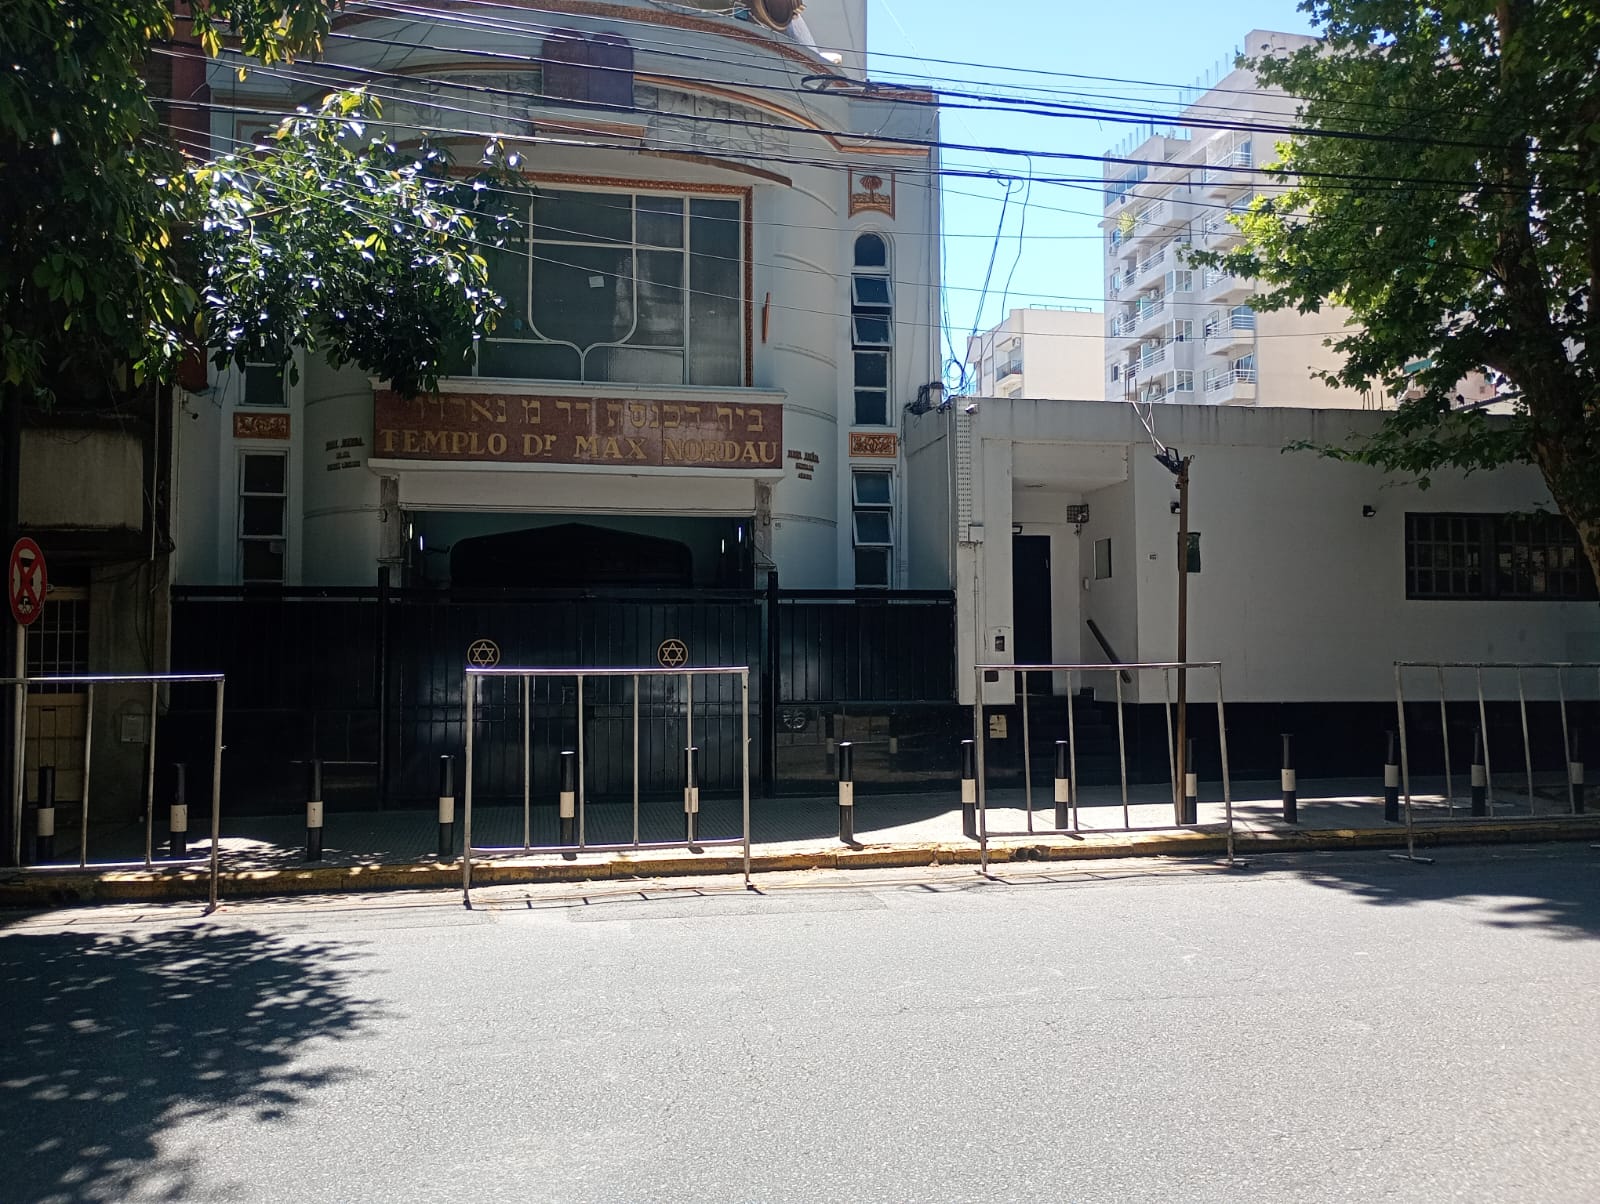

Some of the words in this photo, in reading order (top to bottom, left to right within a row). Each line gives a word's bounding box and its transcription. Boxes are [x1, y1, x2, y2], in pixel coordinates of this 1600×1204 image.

[379, 429, 507, 455] TEMPLO
[522, 433, 557, 457] Dr
[573, 435, 648, 460] MAX
[664, 438, 777, 463] NORDAU
